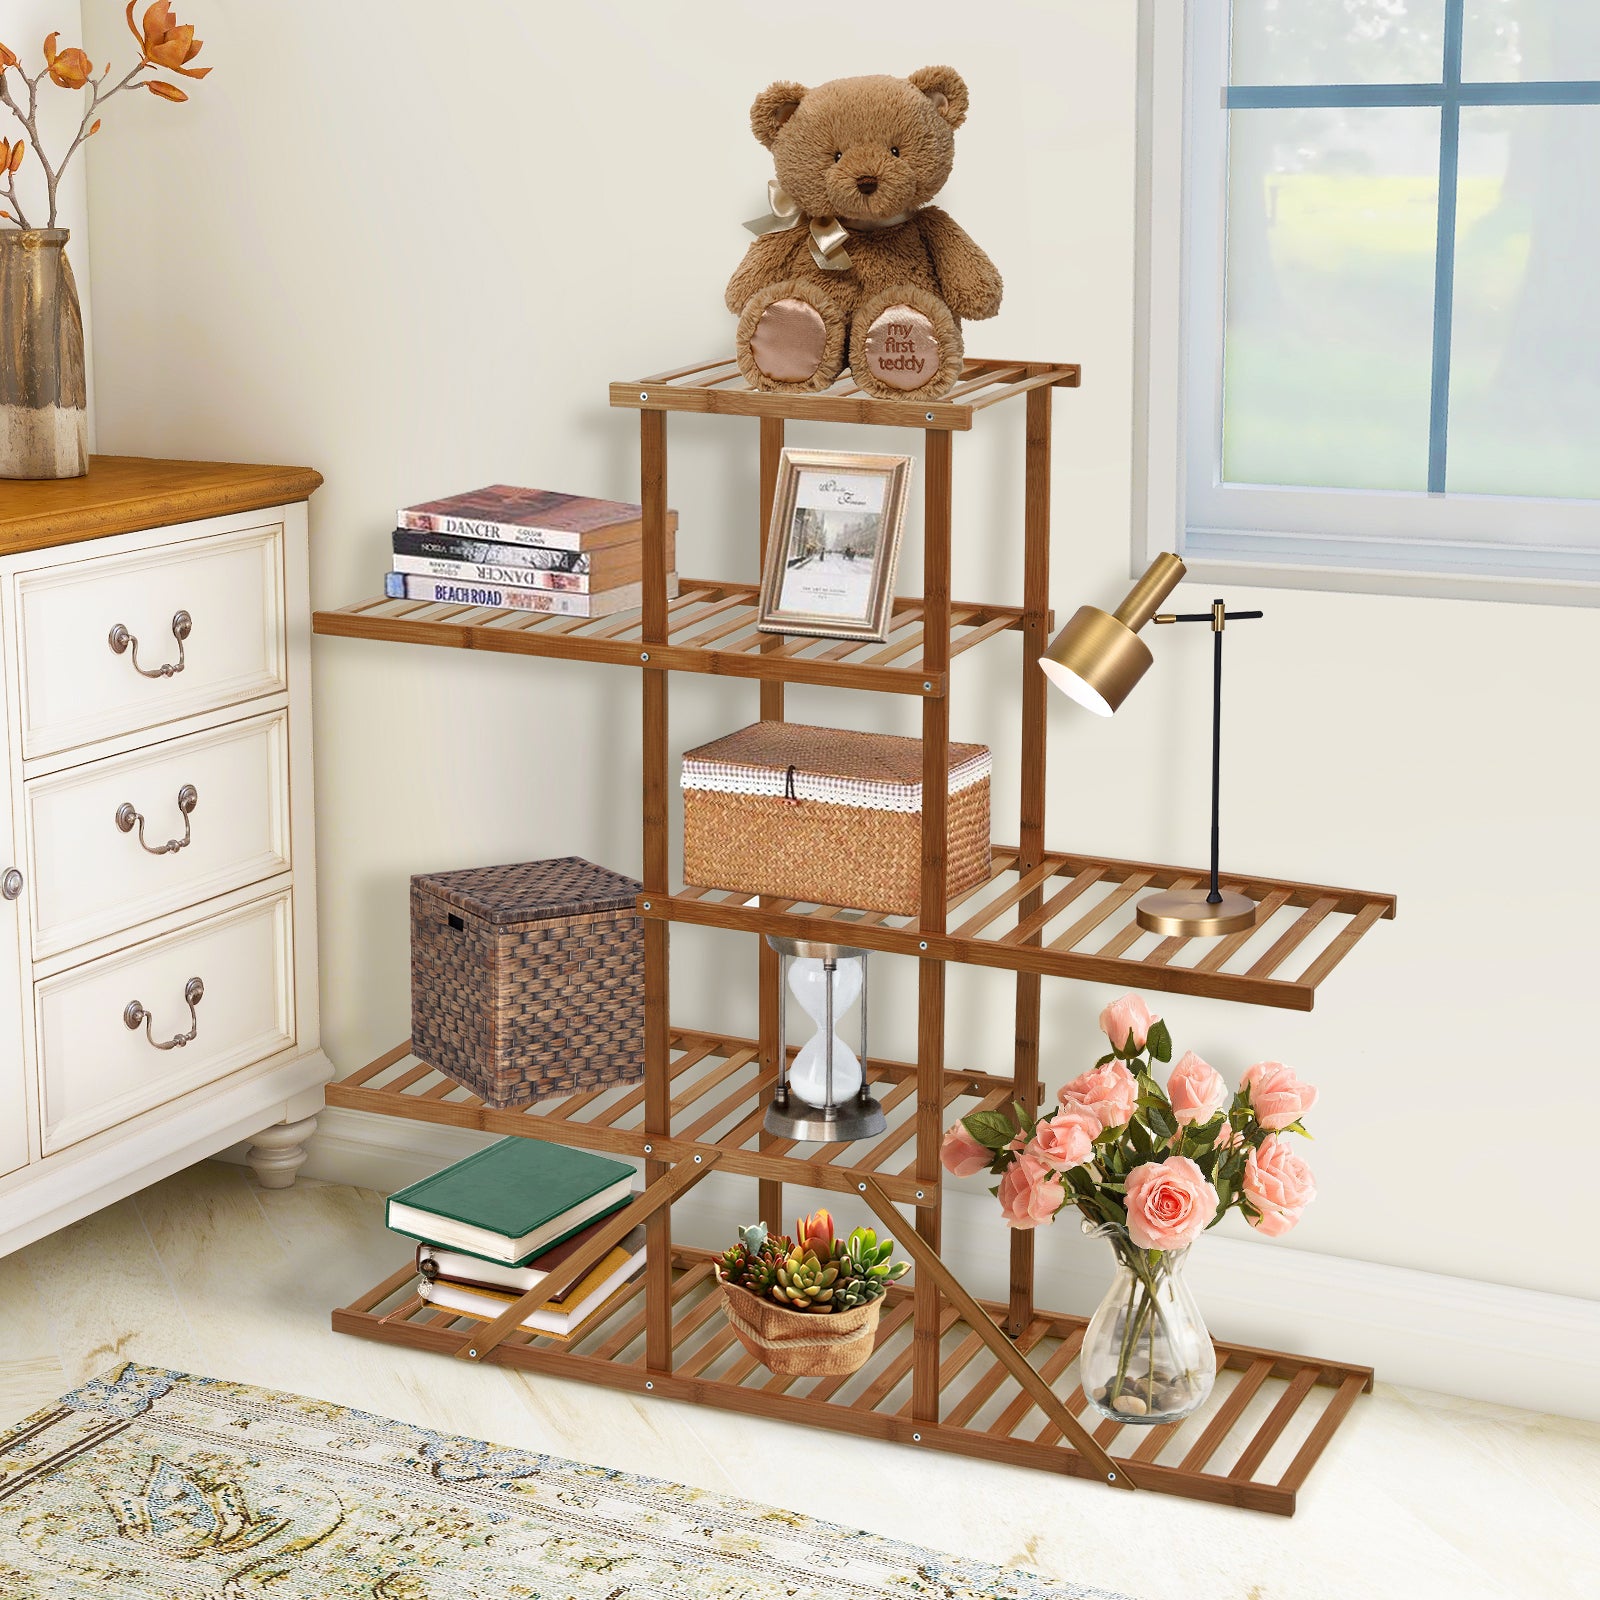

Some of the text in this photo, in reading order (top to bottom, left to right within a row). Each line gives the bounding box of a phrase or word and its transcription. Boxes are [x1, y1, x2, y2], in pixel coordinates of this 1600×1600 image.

[887, 322, 914, 340] my
[884, 336, 915, 353] first
[878, 355, 926, 374] teddy
[445, 519, 501, 539] DANCER
[475, 566, 535, 584] DANCER
[434, 584, 471, 603] BEACH
[471, 590, 503, 606] ROAD
